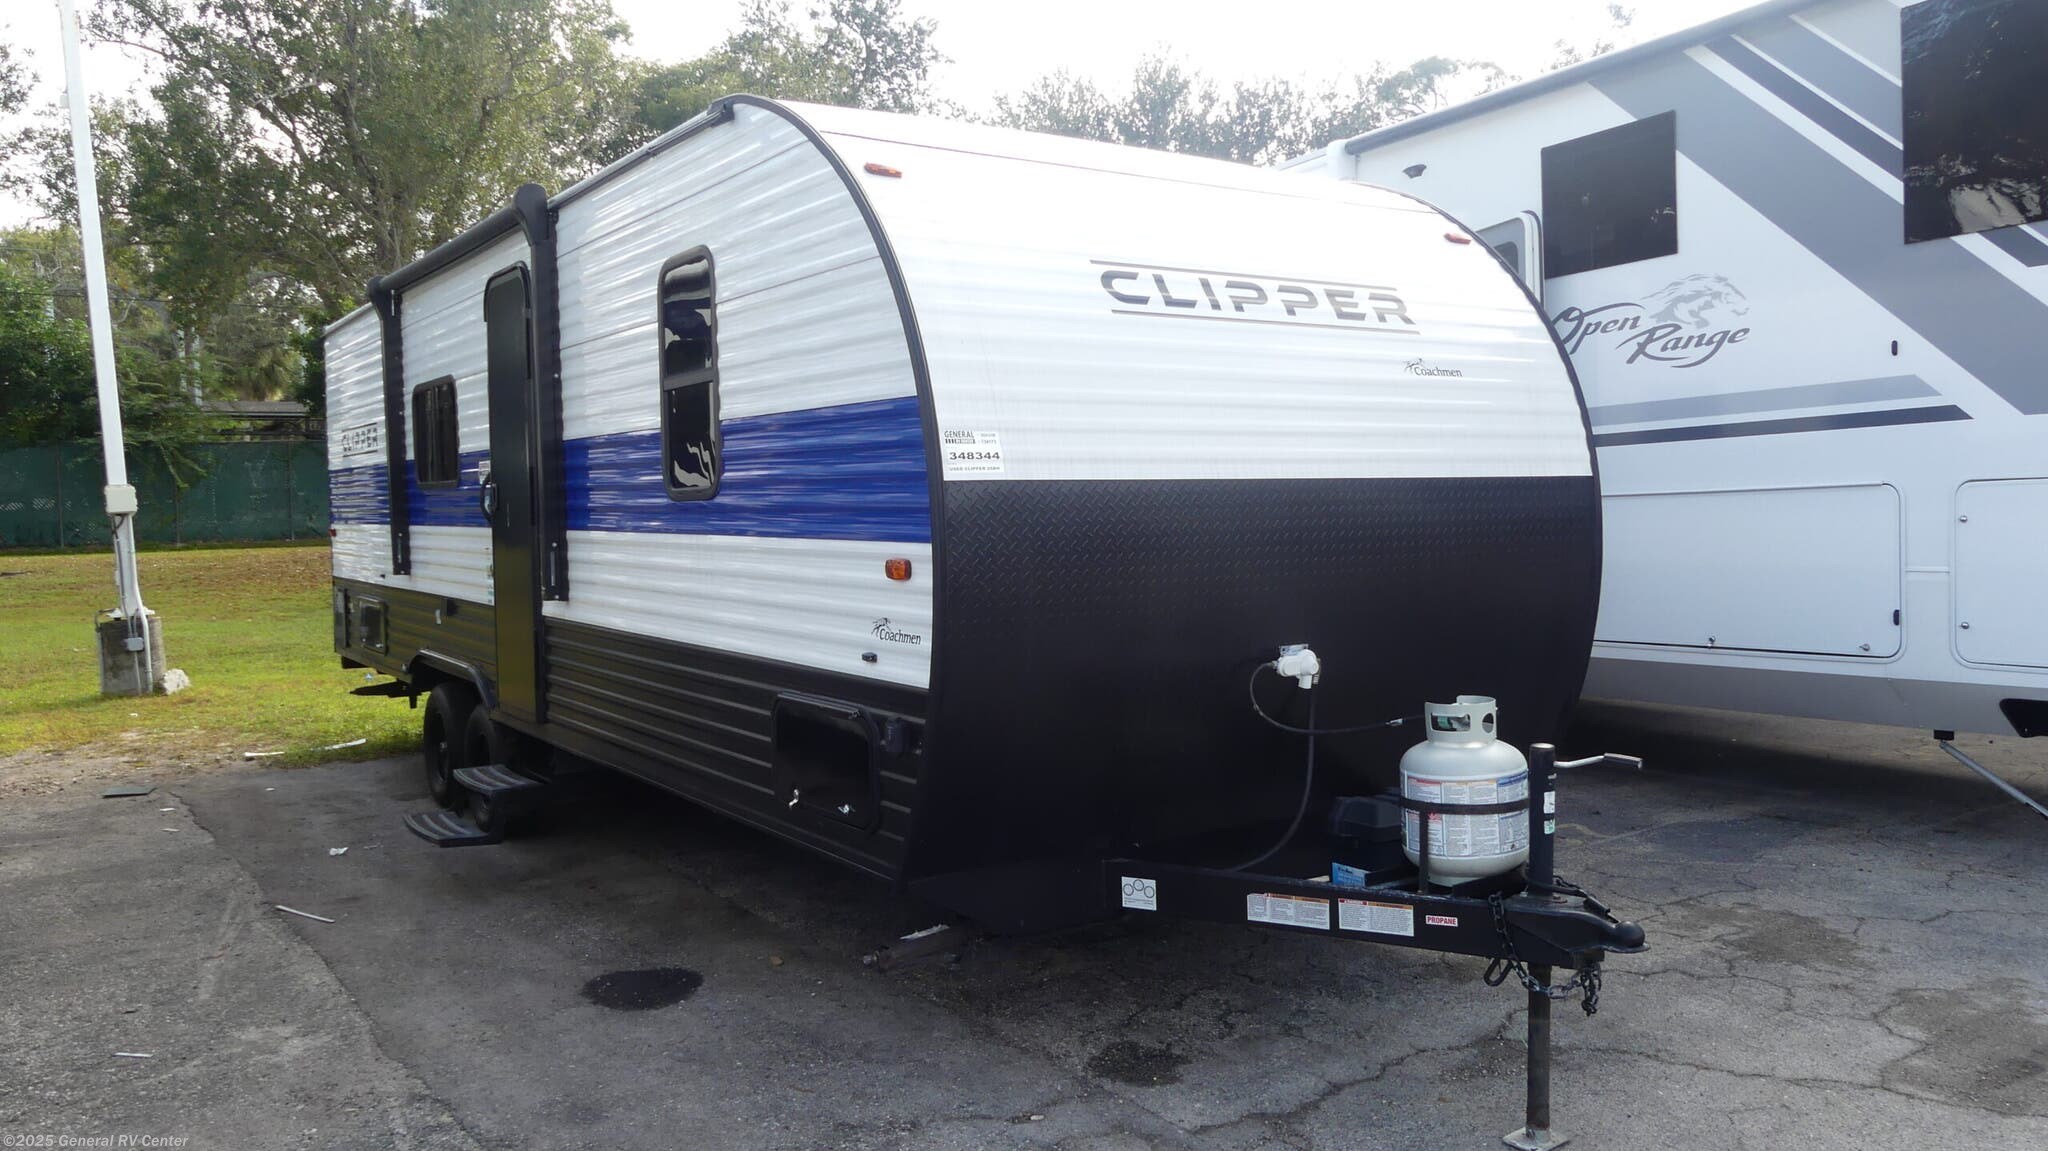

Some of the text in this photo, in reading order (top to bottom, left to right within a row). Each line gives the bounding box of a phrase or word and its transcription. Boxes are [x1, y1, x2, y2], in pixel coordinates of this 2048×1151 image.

[1099, 269, 1416, 325] CLIPPER
[1551, 302, 1646, 355] Open
[1615, 322, 1750, 368] Range
[1414, 366, 1463, 378] Coachmen
[944, 430, 975, 438] GENERAL
[949, 451, 1000, 460] 348344
[879, 627, 921, 645] Coachmen
[1427, 916, 1457, 925] PROPANE
